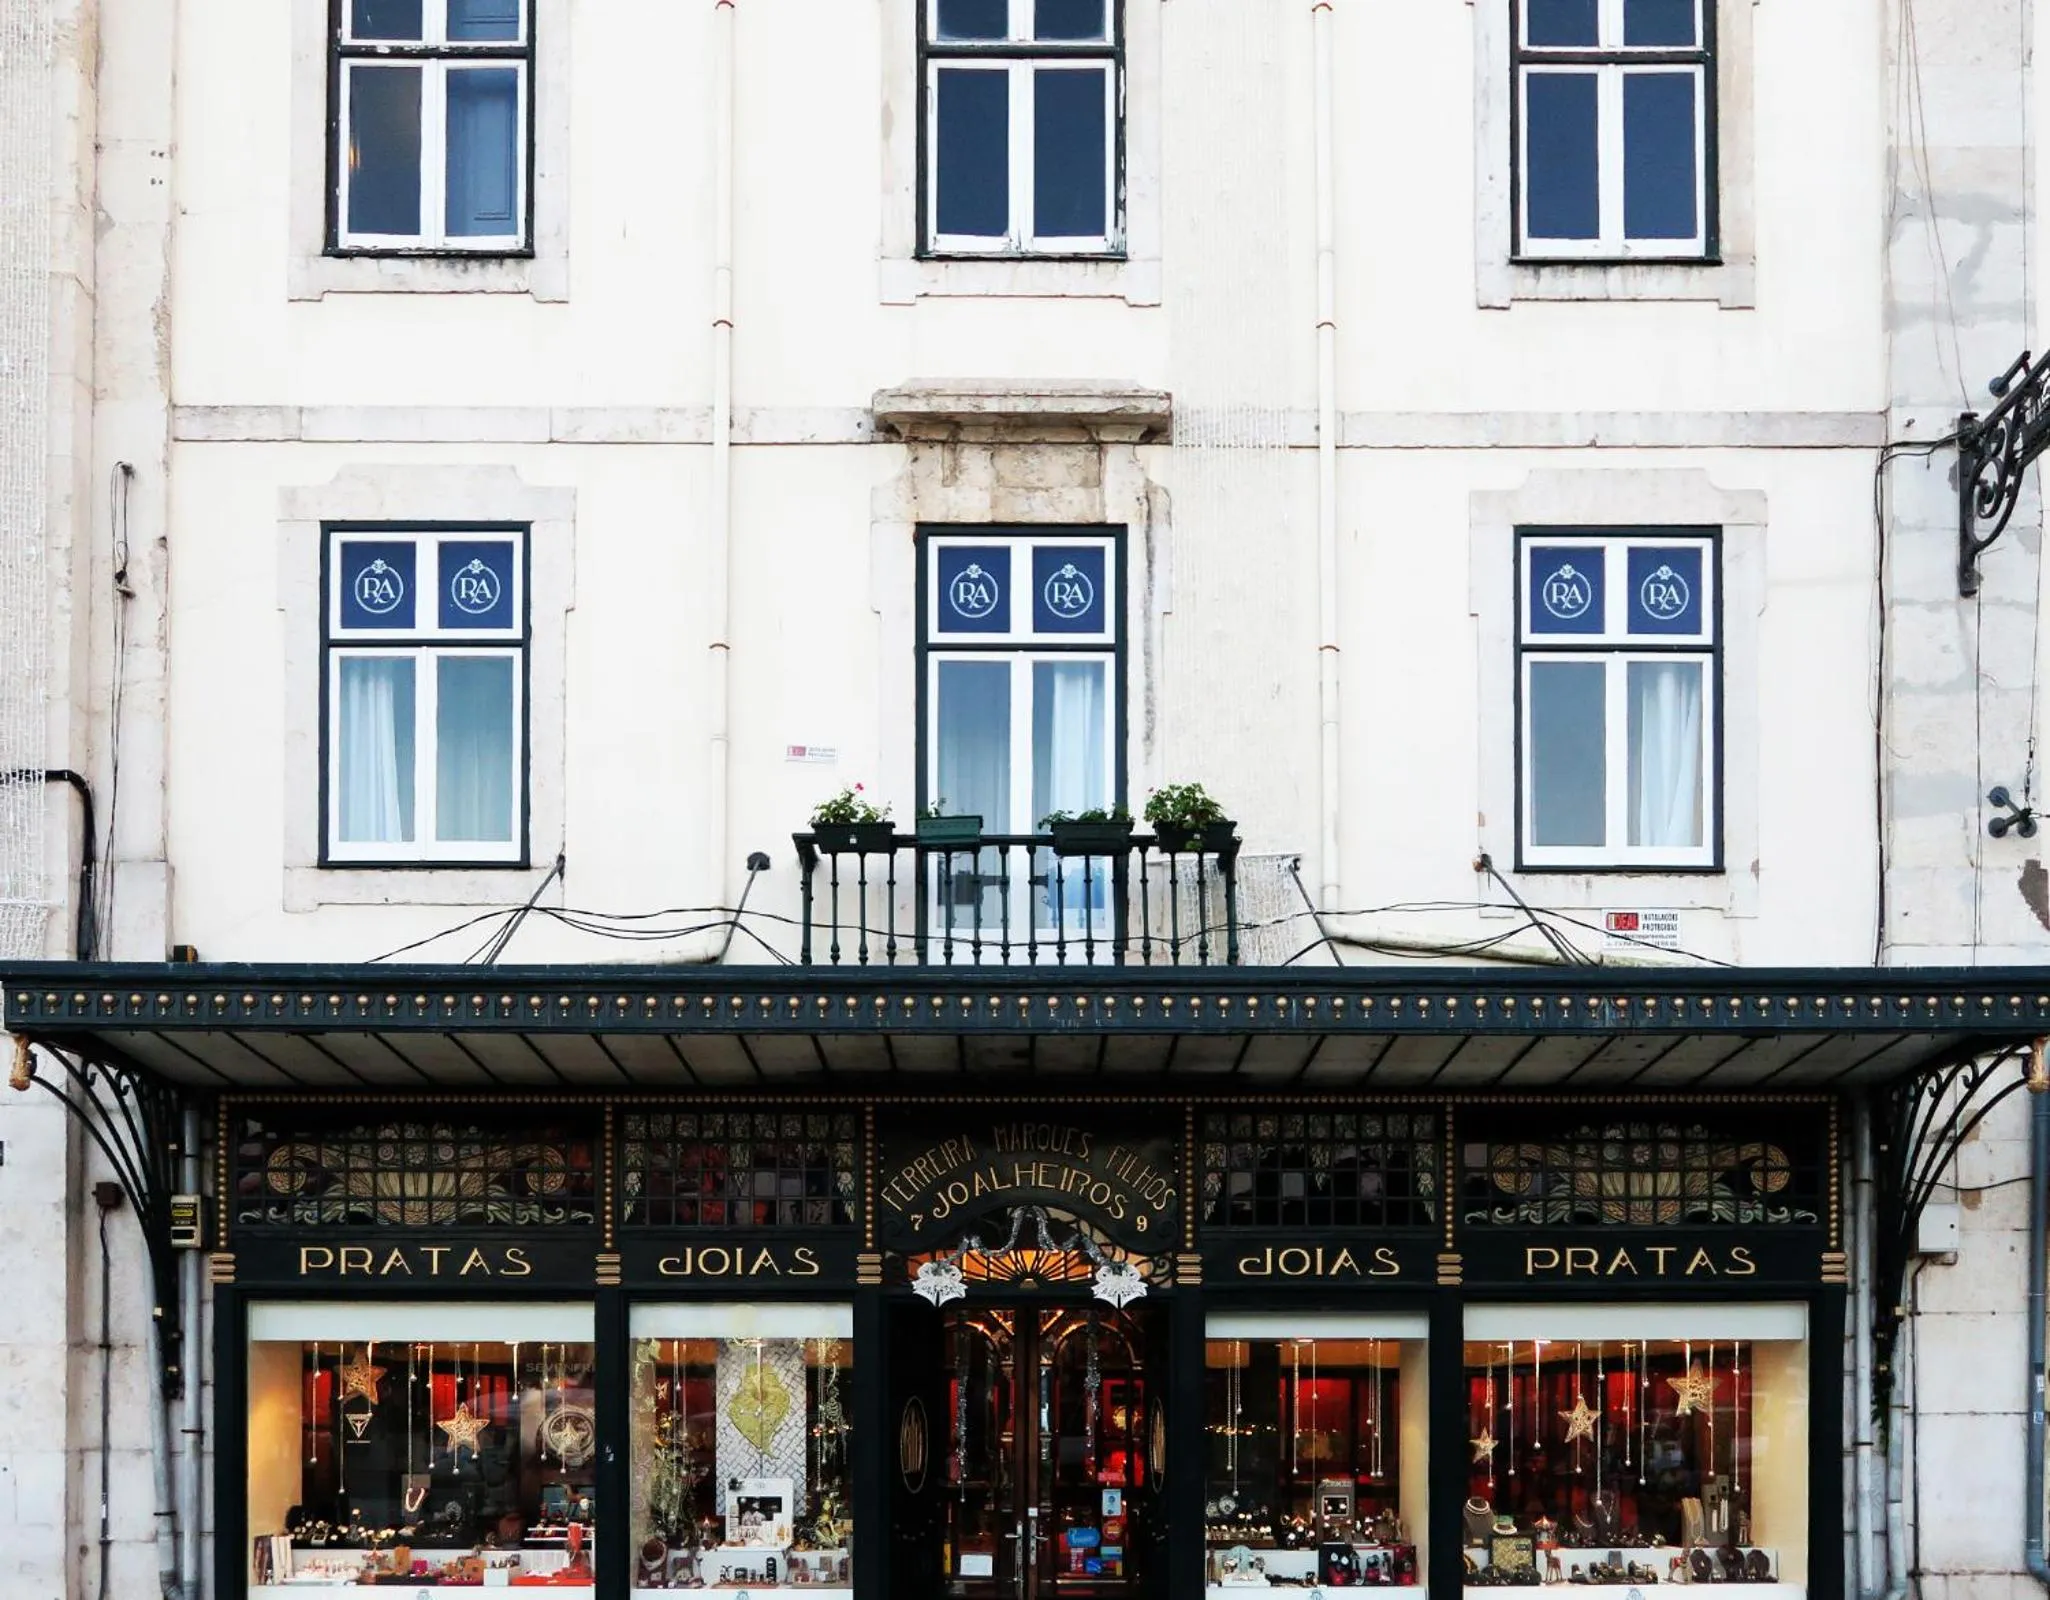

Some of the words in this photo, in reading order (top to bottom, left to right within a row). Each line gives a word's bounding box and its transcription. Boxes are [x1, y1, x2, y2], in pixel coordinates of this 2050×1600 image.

[363, 577, 396, 604] RA
[460, 577, 493, 604] RA
[958, 581, 991, 609] RA
[1053, 581, 1086, 609] RA
[1551, 582, 1584, 609] RA
[1649, 582, 1682, 610] RA
[880, 1133, 977, 1212] FERREIRA
[1104, 1145, 1177, 1211] FILHOS
[932, 1162, 1129, 1219] JOALHEIROS
[910, 1213, 924, 1232] 7
[1136, 1215, 1148, 1232] 9
[299, 1246, 534, 1276] PRATAS
[658, 1246, 821, 1276] JOIAS
[1237, 1246, 1402, 1276] JOIAS
[1525, 1246, 1758, 1276] PRATAS
